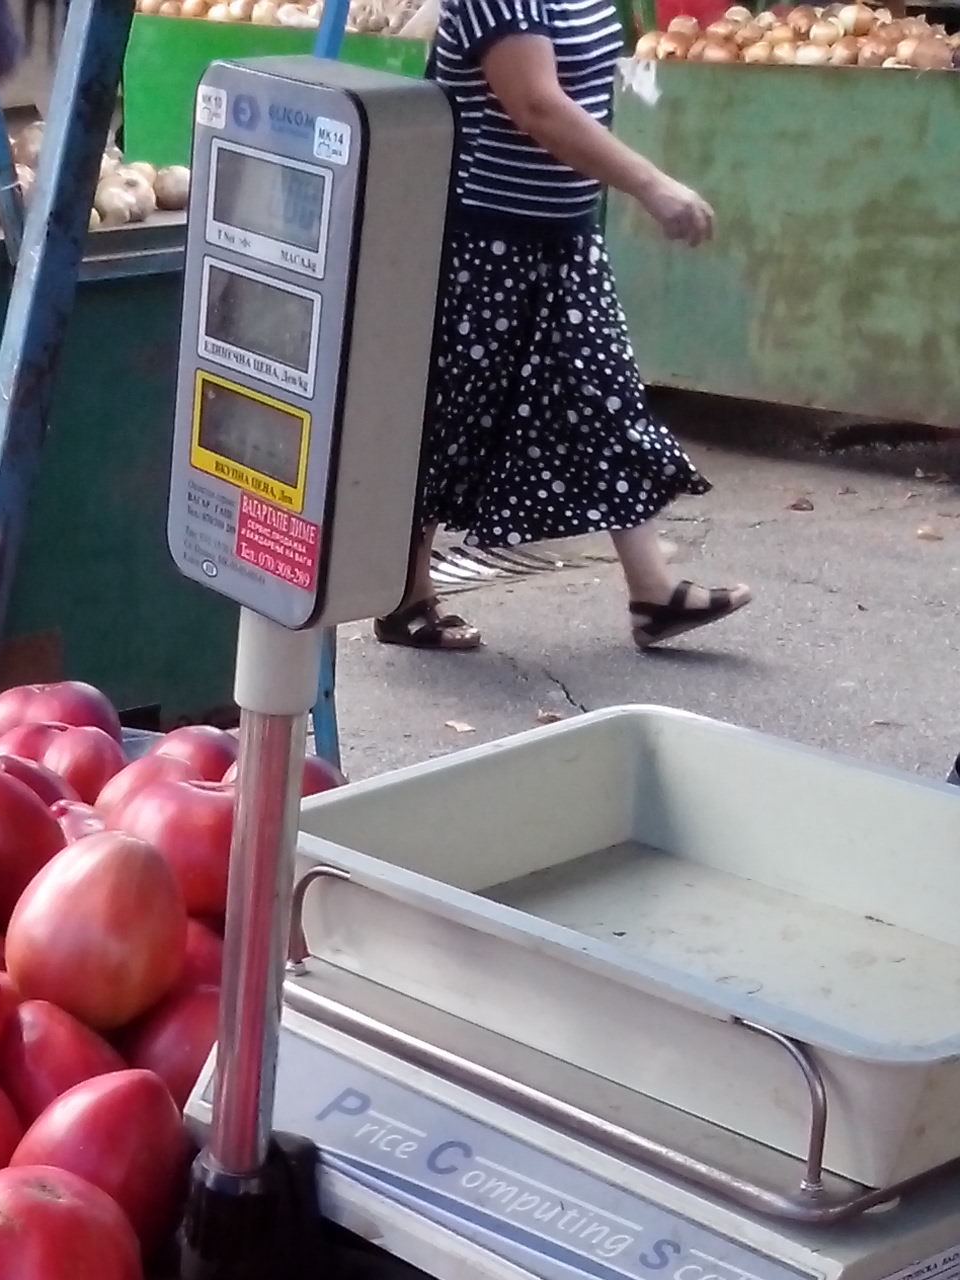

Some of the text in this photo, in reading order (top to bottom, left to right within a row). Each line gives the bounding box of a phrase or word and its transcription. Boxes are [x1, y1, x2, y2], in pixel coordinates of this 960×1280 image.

[318, 127, 332, 142] MK
[334, 132, 344, 145] 14
[316, 1086, 418, 1159] Price
[426, 1139, 640, 1258] Computing
